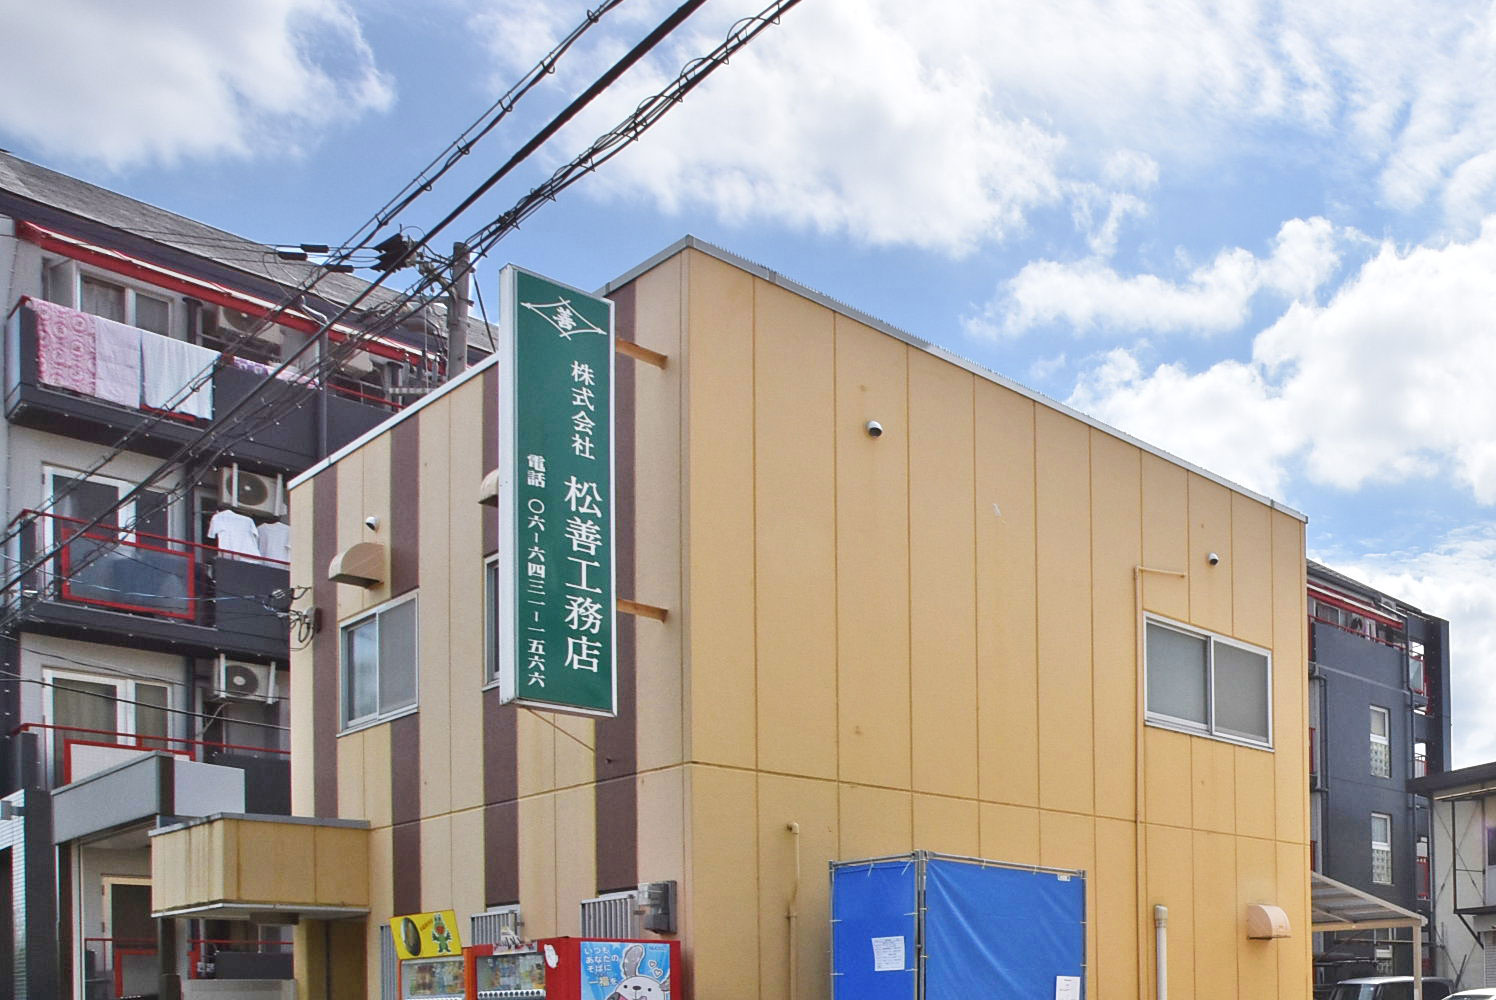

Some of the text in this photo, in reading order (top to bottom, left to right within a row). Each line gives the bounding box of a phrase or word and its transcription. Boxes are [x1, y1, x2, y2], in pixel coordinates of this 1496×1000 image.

[527, 454, 546, 488] 電話
[564, 361, 602, 673] 株式会社 松善工務店
